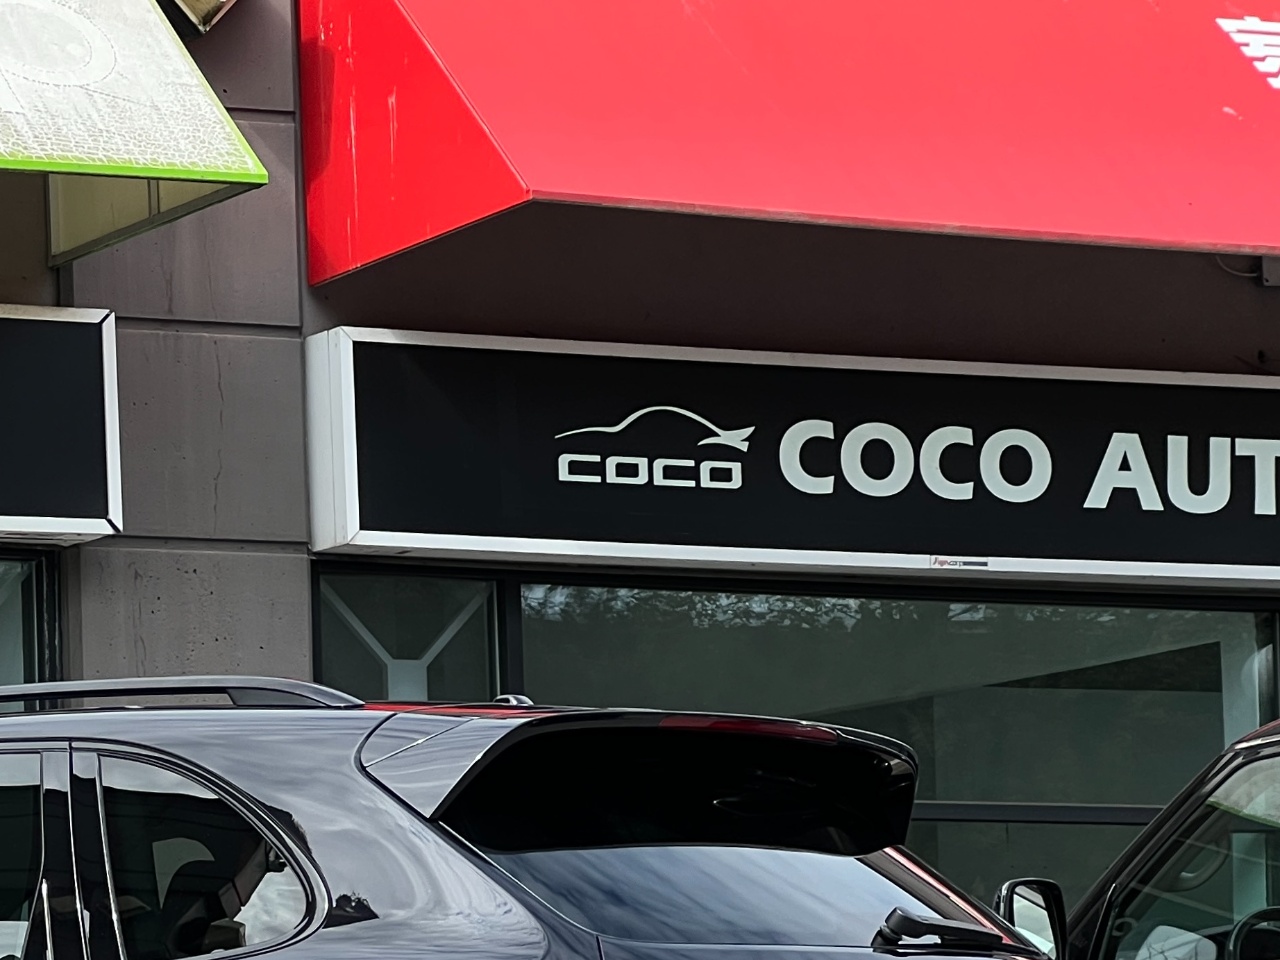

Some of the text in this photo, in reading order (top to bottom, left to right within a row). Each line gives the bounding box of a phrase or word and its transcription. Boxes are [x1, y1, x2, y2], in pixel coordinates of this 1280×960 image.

[557, 453, 743, 490] COCO
[779, 419, 1280, 516] COCO AUT
